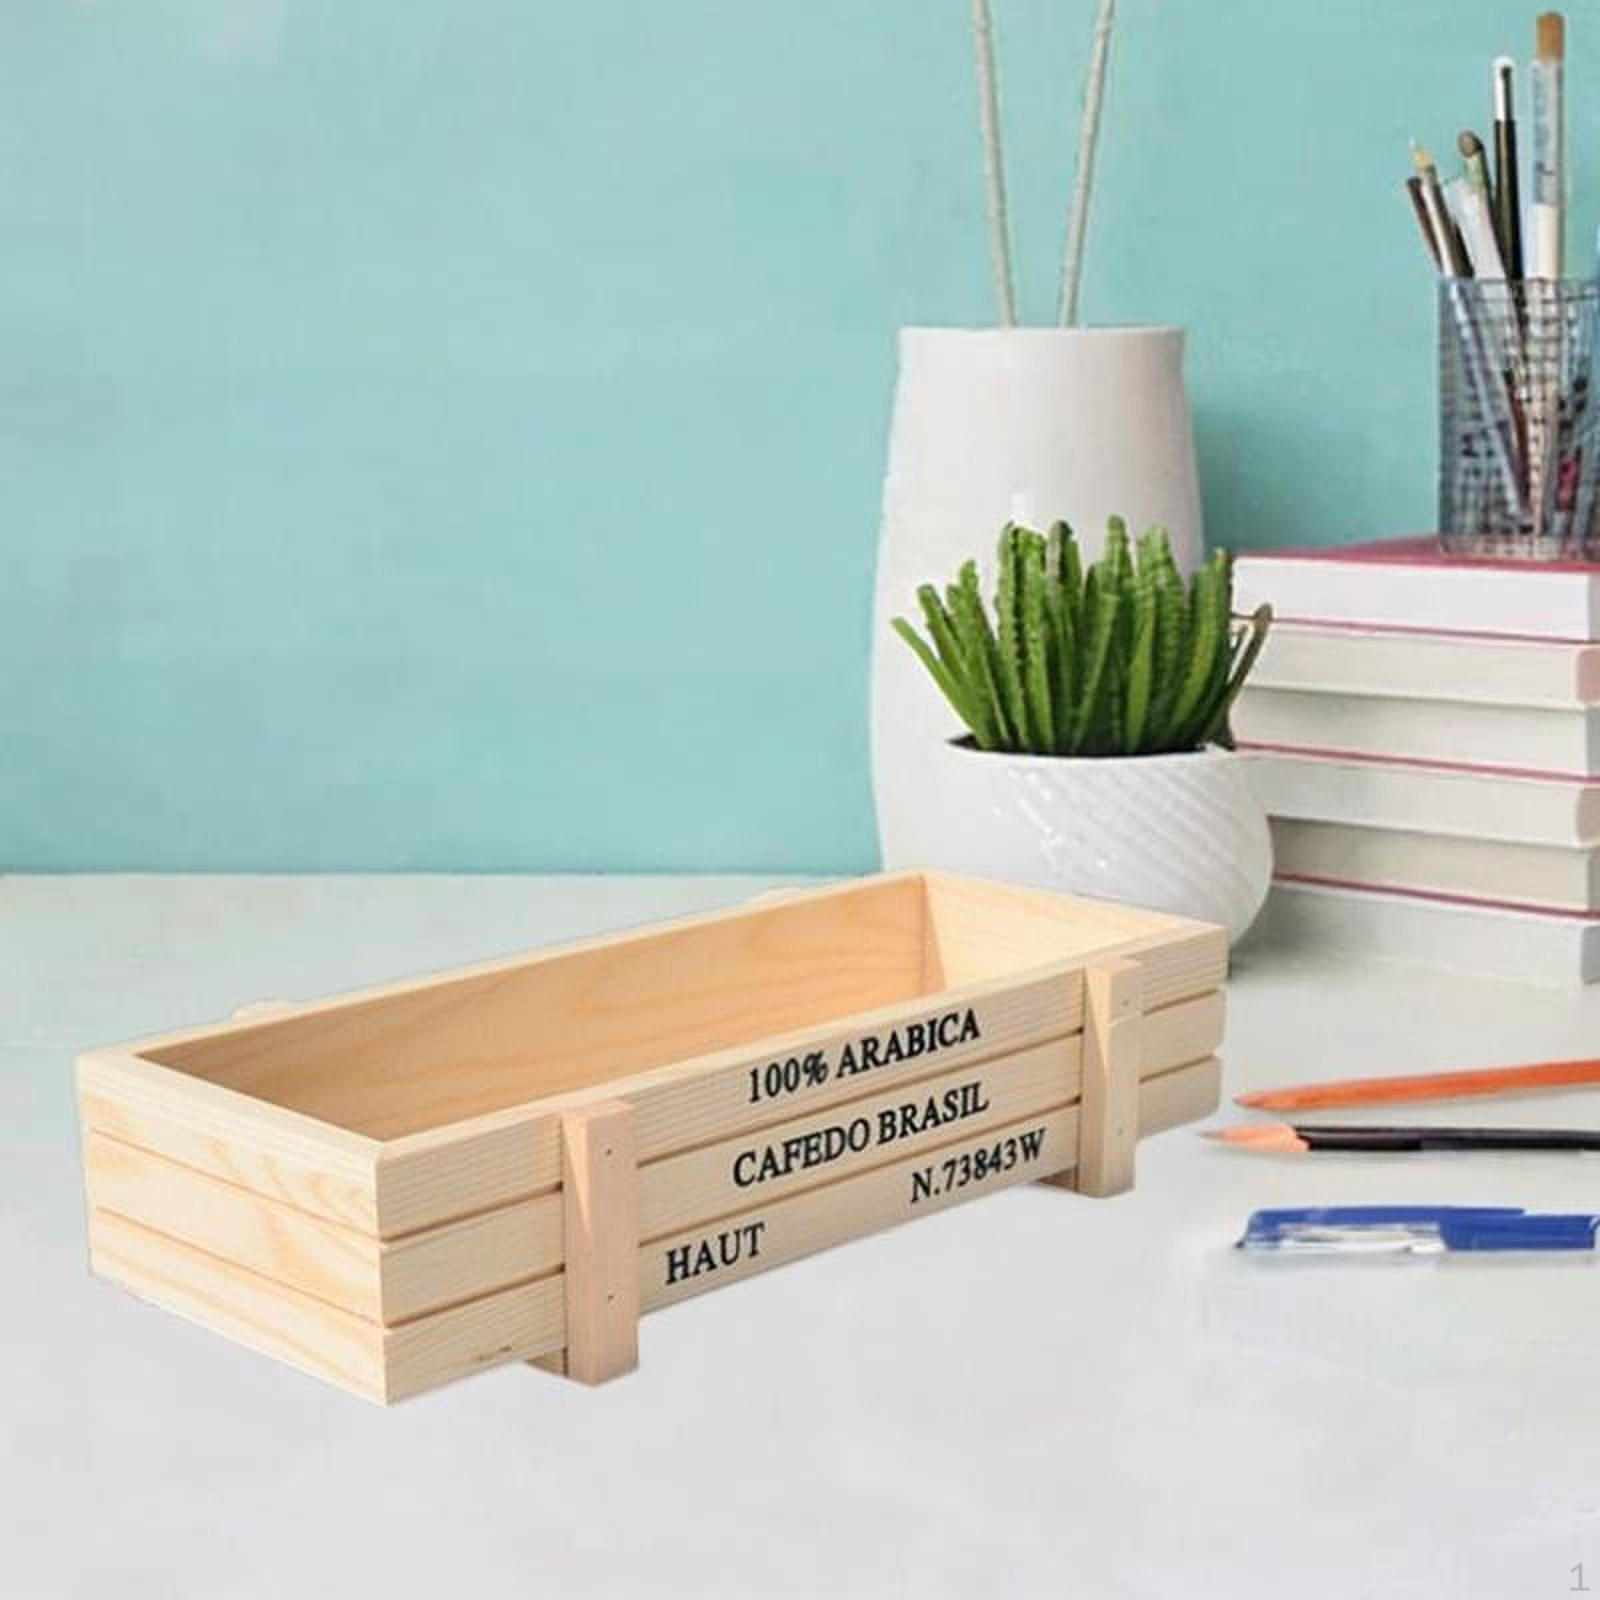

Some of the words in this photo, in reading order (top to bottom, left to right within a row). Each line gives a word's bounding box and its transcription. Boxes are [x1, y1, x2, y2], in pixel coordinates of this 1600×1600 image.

[748, 1051, 829, 1104] 100%
[836, 1008, 981, 1079] ARABICA
[877, 1081, 990, 1145] BRASIL
[910, 1127, 1047, 1204] N.73843W
[665, 1221, 766, 1286] HAUT
